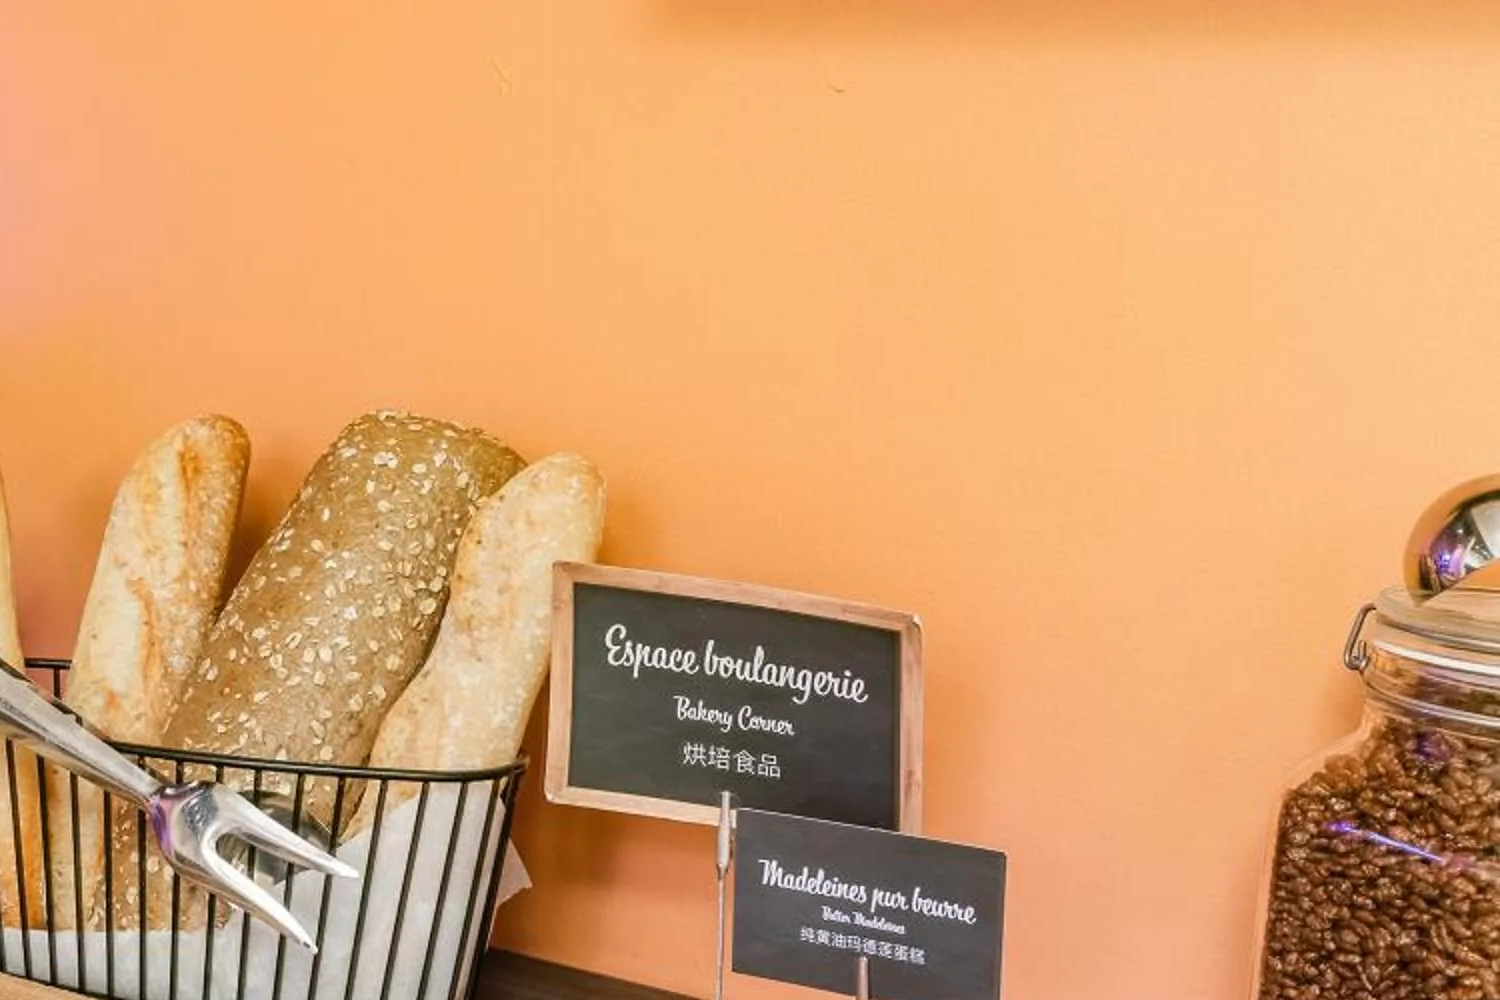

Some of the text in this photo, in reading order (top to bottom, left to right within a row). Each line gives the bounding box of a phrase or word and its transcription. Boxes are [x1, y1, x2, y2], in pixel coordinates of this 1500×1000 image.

[605, 623, 868, 704] Espace boulangerie
[673, 696, 795, 736] Bakery Corner
[683, 742, 781, 778] 烘培食品
[758, 858, 977, 925] Madeleines pur beurre
